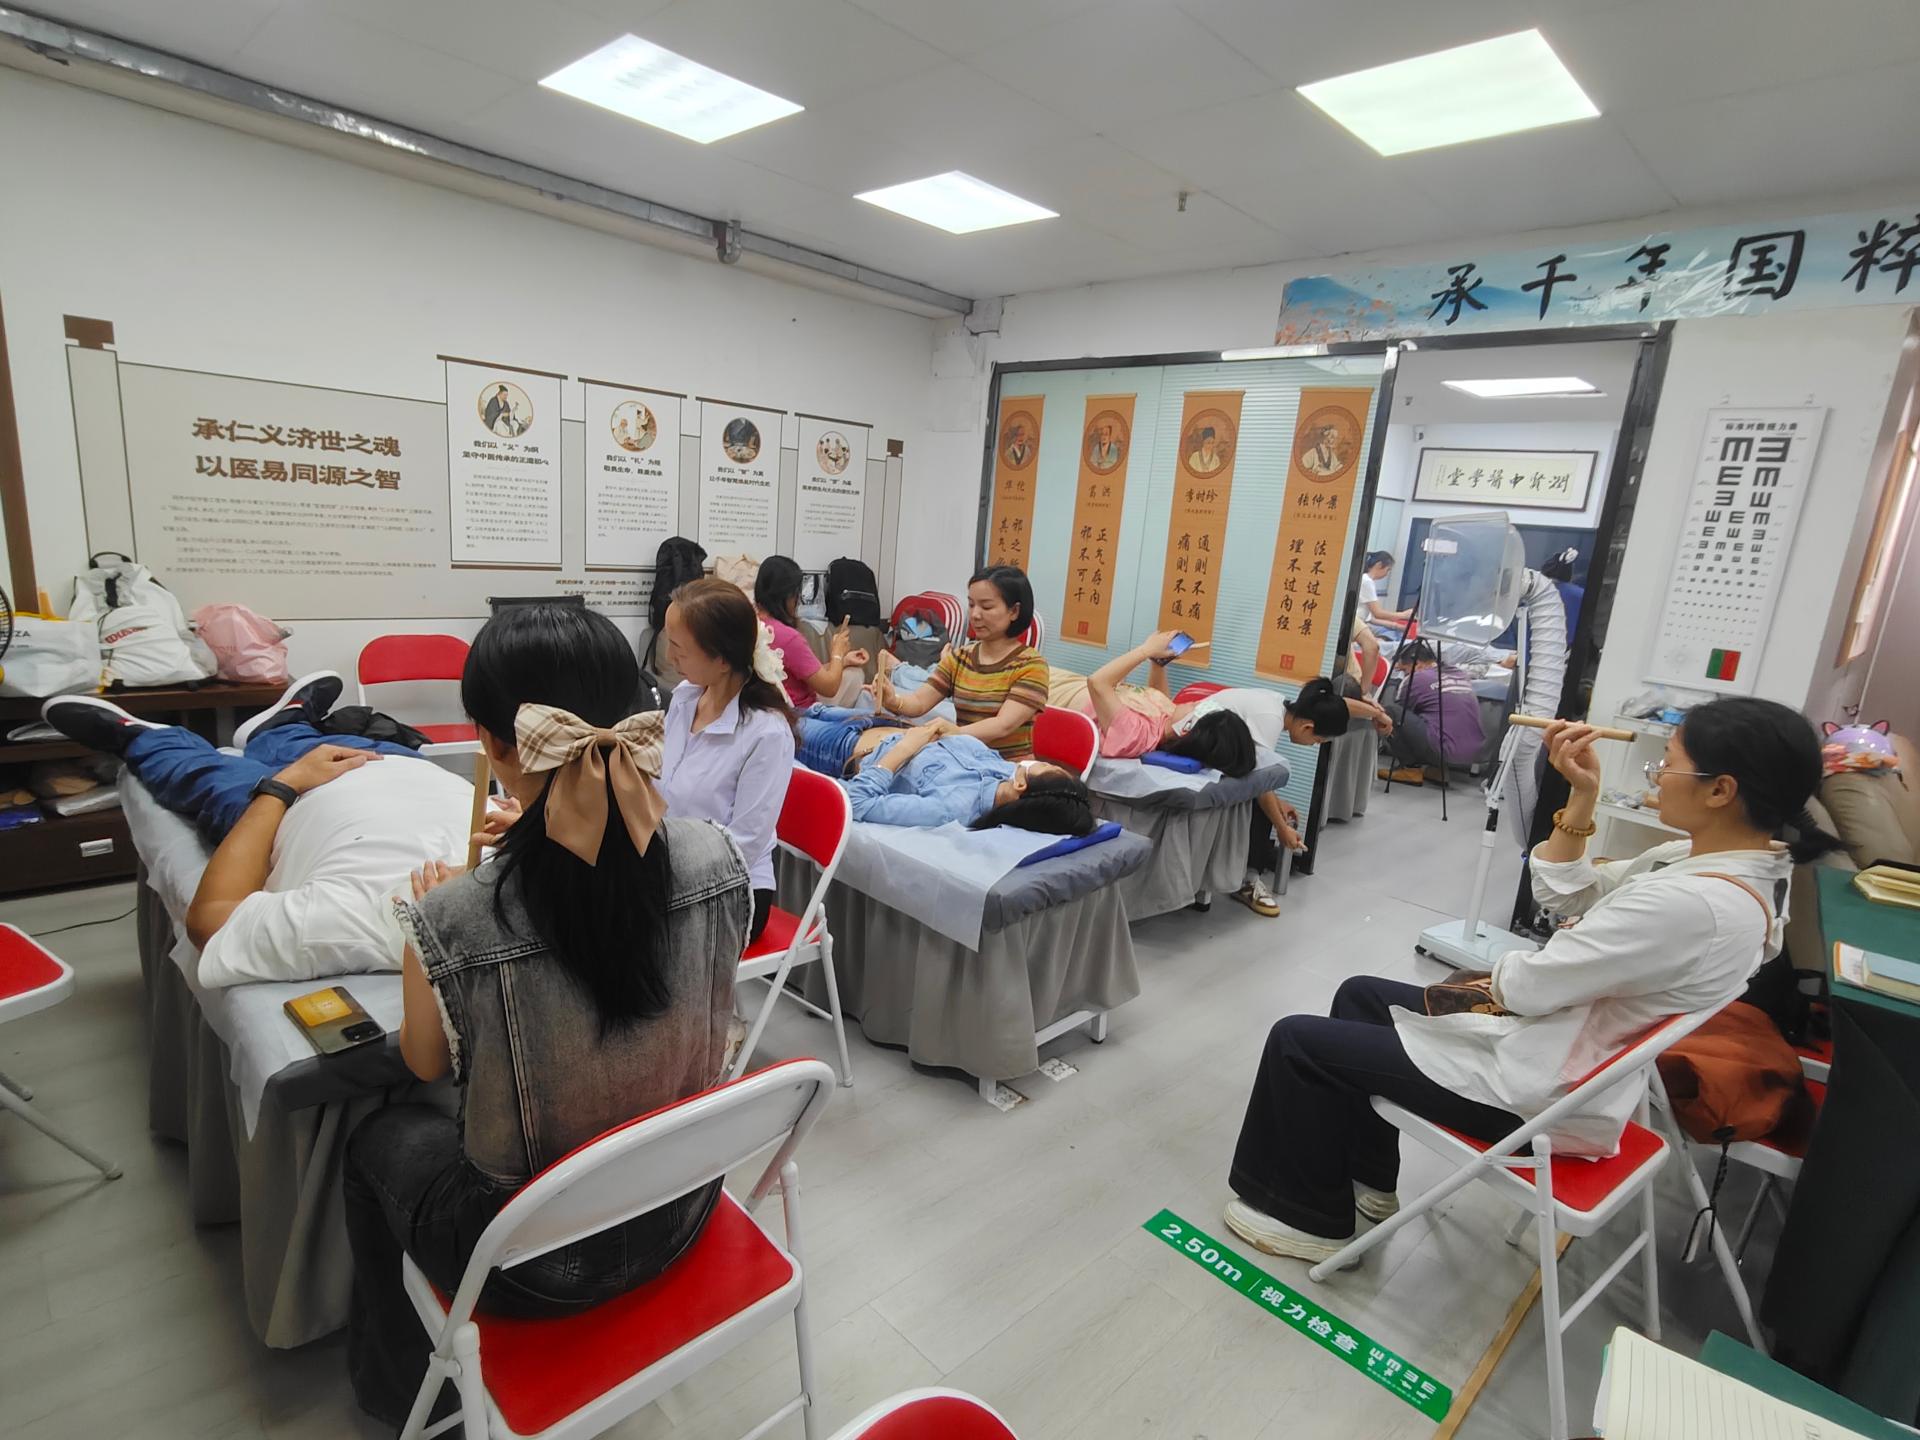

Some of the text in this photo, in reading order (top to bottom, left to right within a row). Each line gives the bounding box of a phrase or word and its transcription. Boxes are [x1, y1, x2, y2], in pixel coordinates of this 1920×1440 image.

[192, 417, 401, 458] 承仁义济世之魂
[195, 455, 401, 491] 以医易同源之智
[1185, 488, 1218, 503] 李时珍
[1297, 493, 1339, 510] 张仲景
[1160, 1223, 1360, 1354] 2.50m 视力检查
